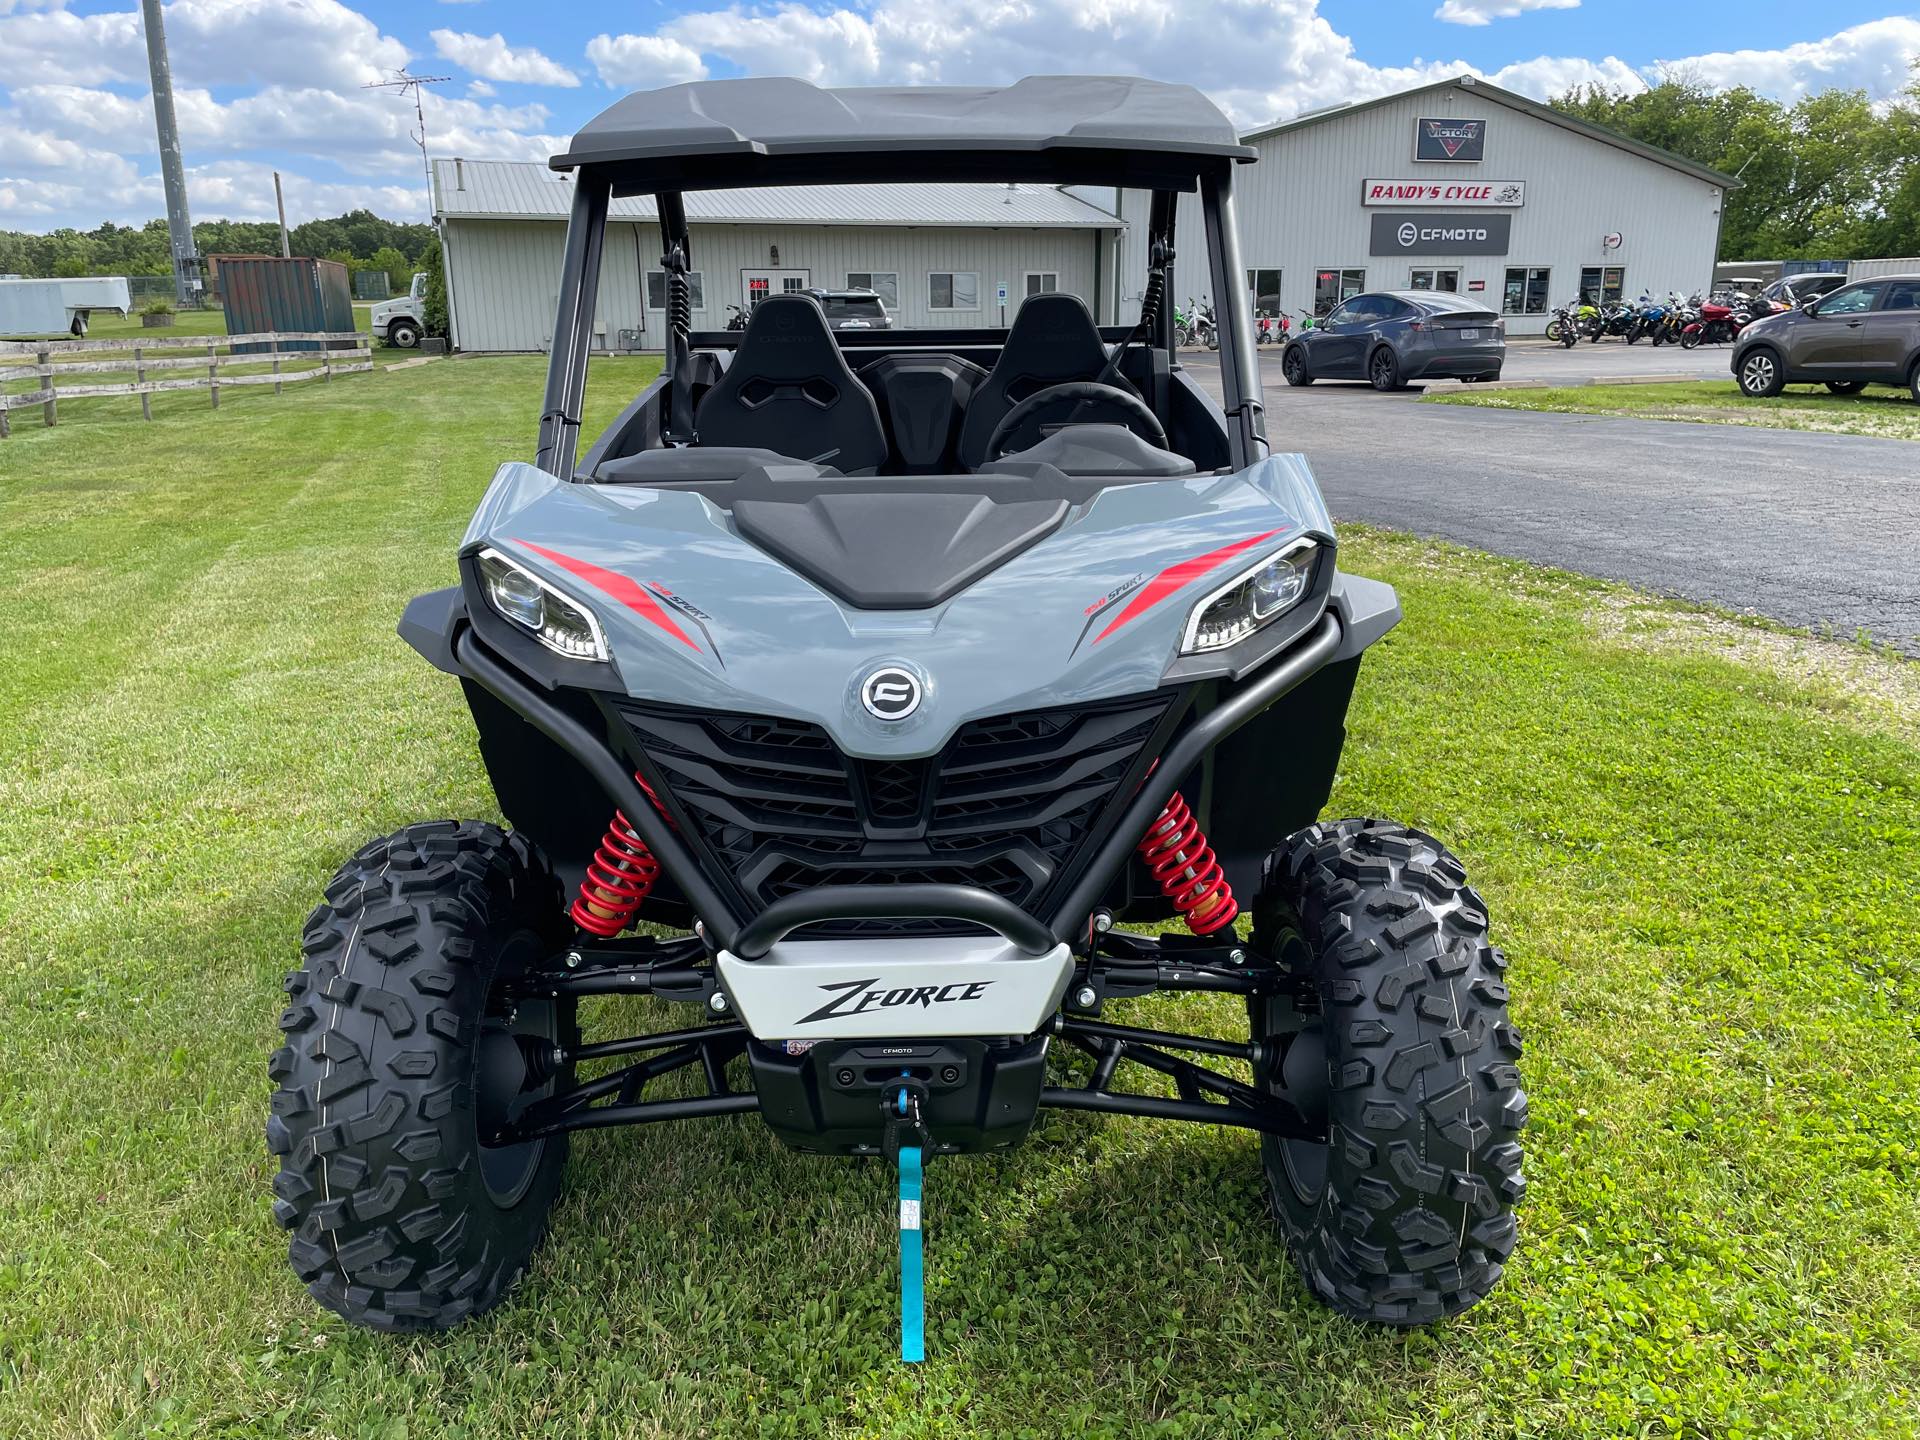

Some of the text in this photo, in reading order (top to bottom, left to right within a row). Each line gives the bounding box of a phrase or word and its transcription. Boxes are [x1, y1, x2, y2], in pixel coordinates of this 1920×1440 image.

[1428, 129, 1477, 138] VICTORY
[1370, 185, 1492, 199] RANDY'S CYCLE
[1420, 228, 1487, 241] CFMOTO
[1108, 572, 1144, 600] SPORT
[669, 596, 713, 620] SPORT
